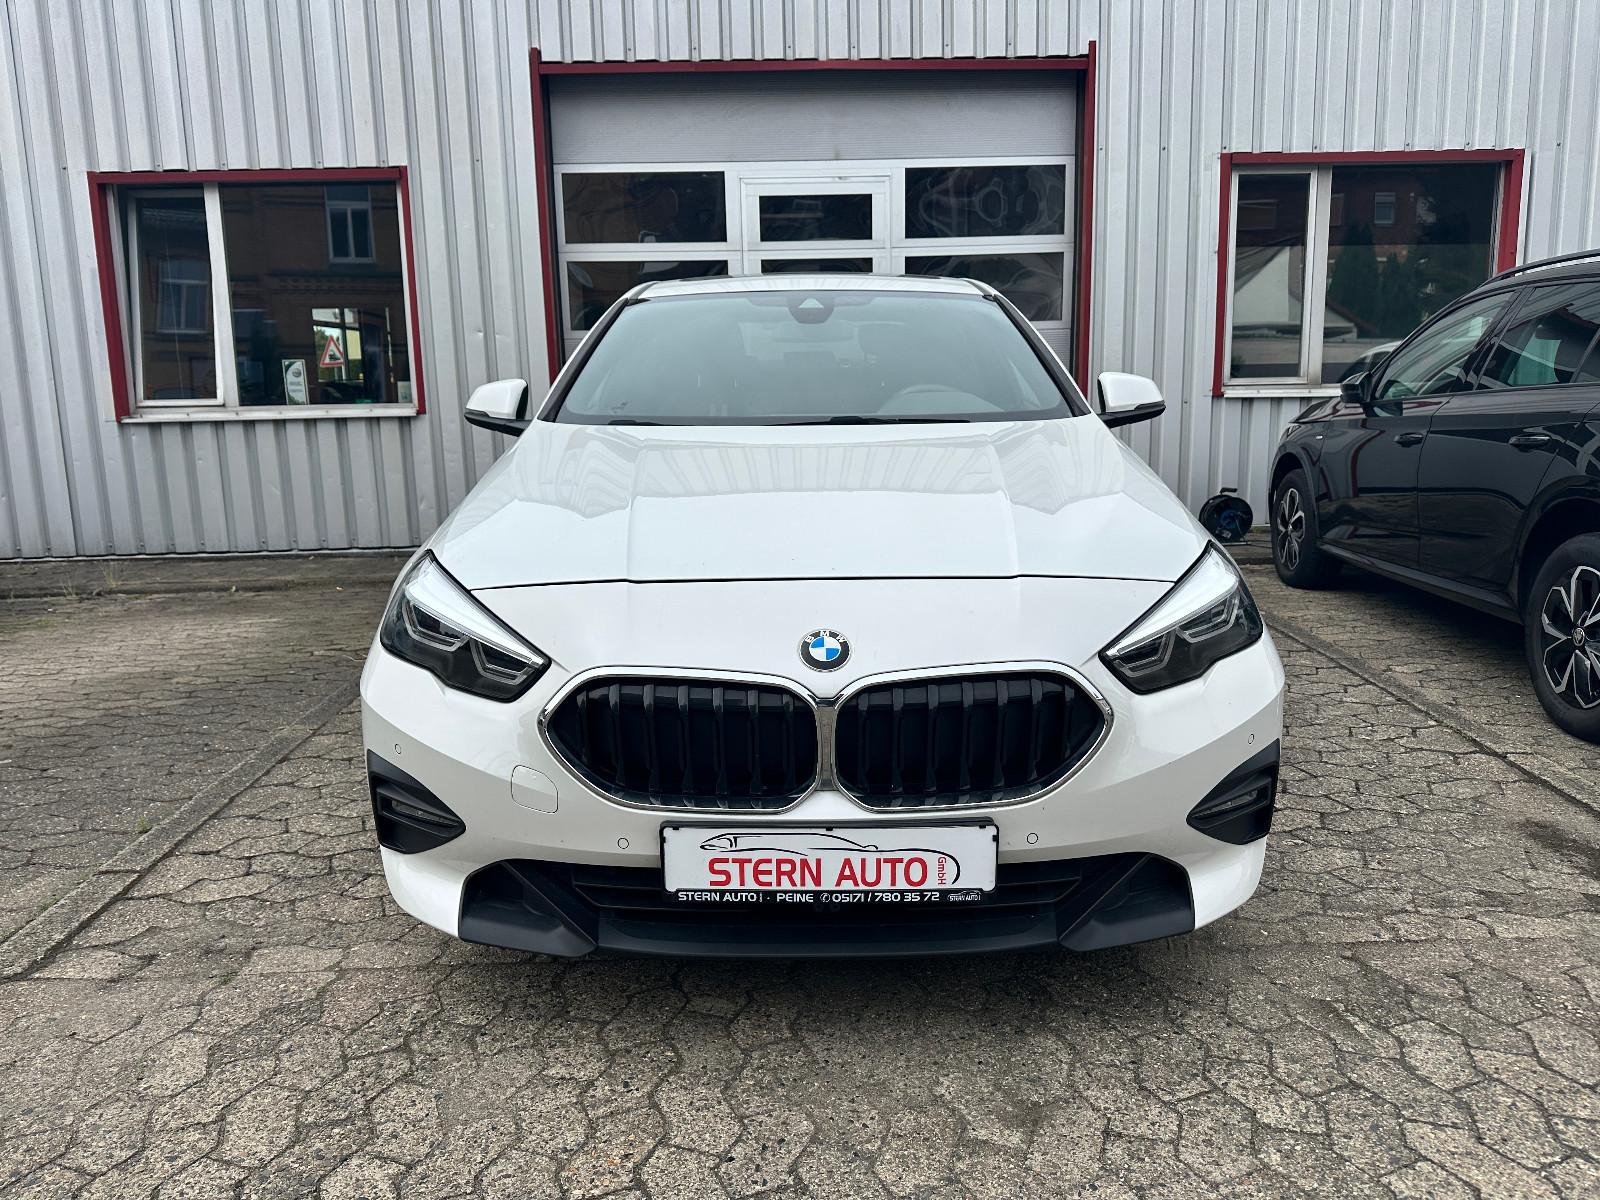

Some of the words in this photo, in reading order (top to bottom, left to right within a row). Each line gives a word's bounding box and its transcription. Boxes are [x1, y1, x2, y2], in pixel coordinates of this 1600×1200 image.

[804, 629, 847, 643] BMW
[708, 857, 823, 887] STERN
[834, 856, 928, 887] AUTO
[937, 856, 947, 886] GmbH
[677, 891, 720, 902] STERN
[722, 892, 757, 902] AUTO
[776, 892, 814, 903] PEINE
[832, 892, 865, 903] 05171
[874, 892, 901, 903] 780
[903, 892, 921, 902] 35
[923, 891, 940, 901] 72
